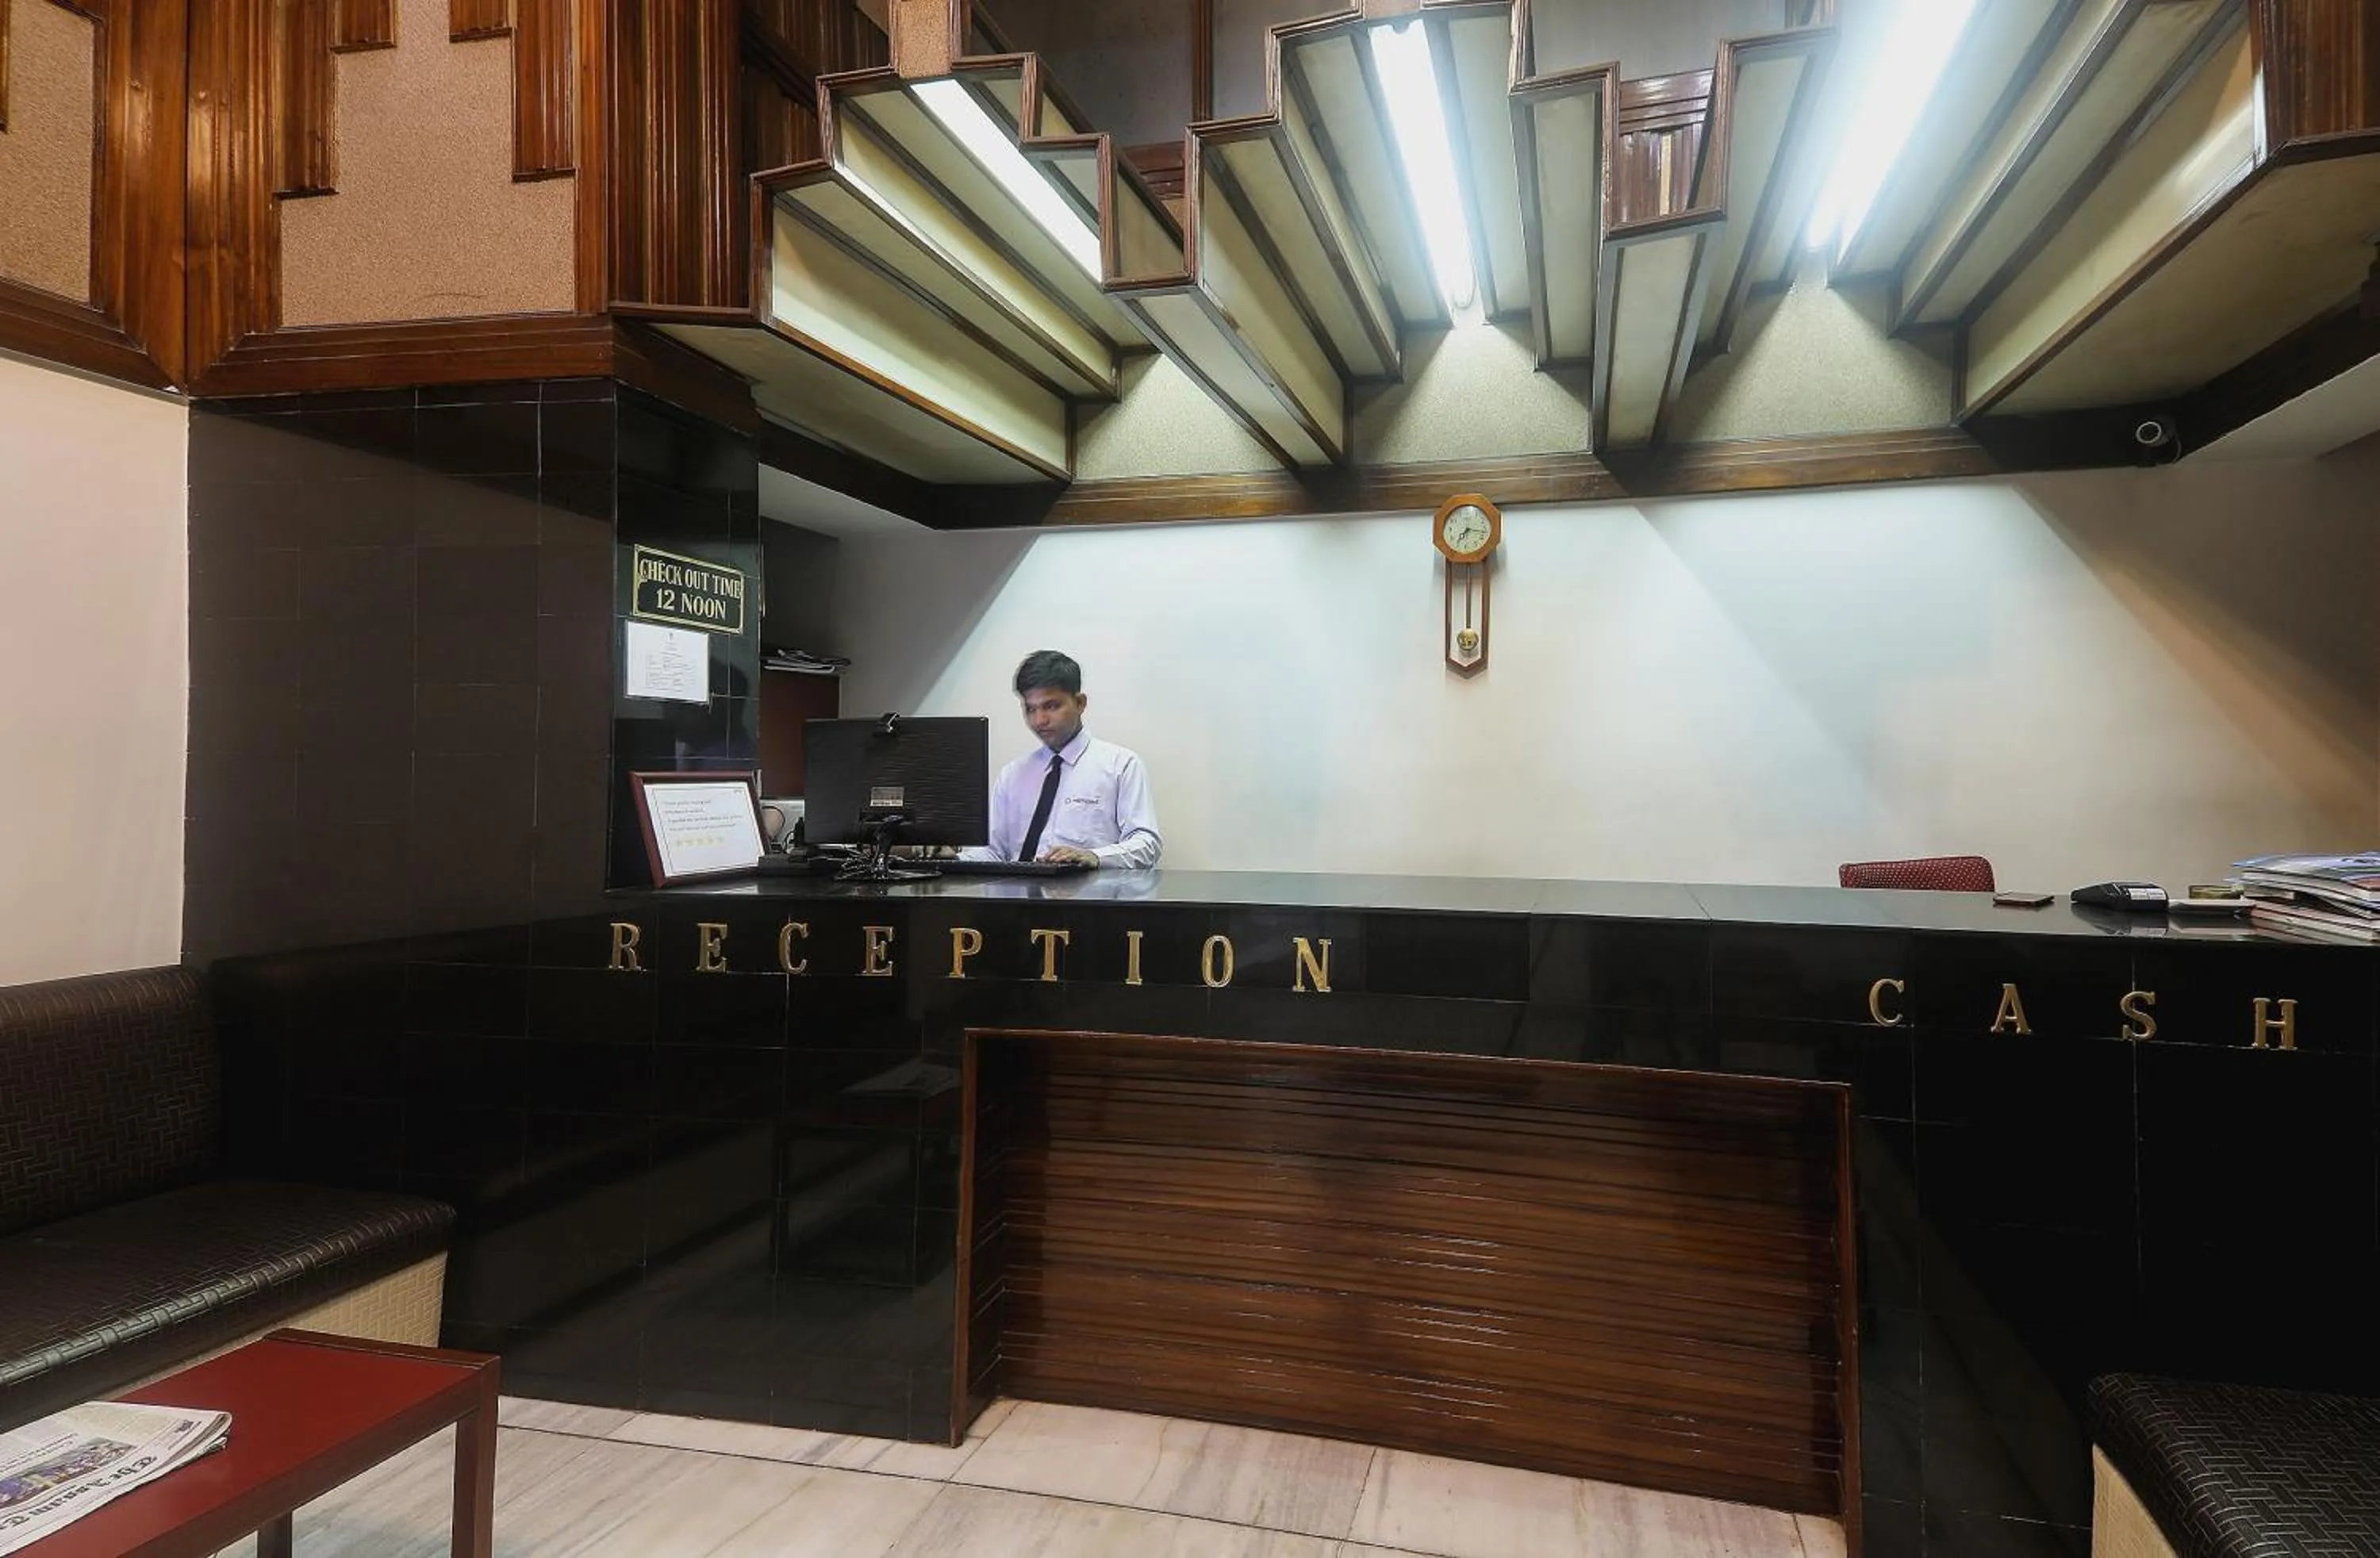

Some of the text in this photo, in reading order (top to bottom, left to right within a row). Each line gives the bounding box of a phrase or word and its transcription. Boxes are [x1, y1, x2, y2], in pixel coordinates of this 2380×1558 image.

[639, 558, 741, 599] CHECK OUT TIME
[656, 588, 727, 620] 12 NOON
[608, 922, 1333, 992] RECEPTION
[1868, 977, 2298, 1051] CASH
